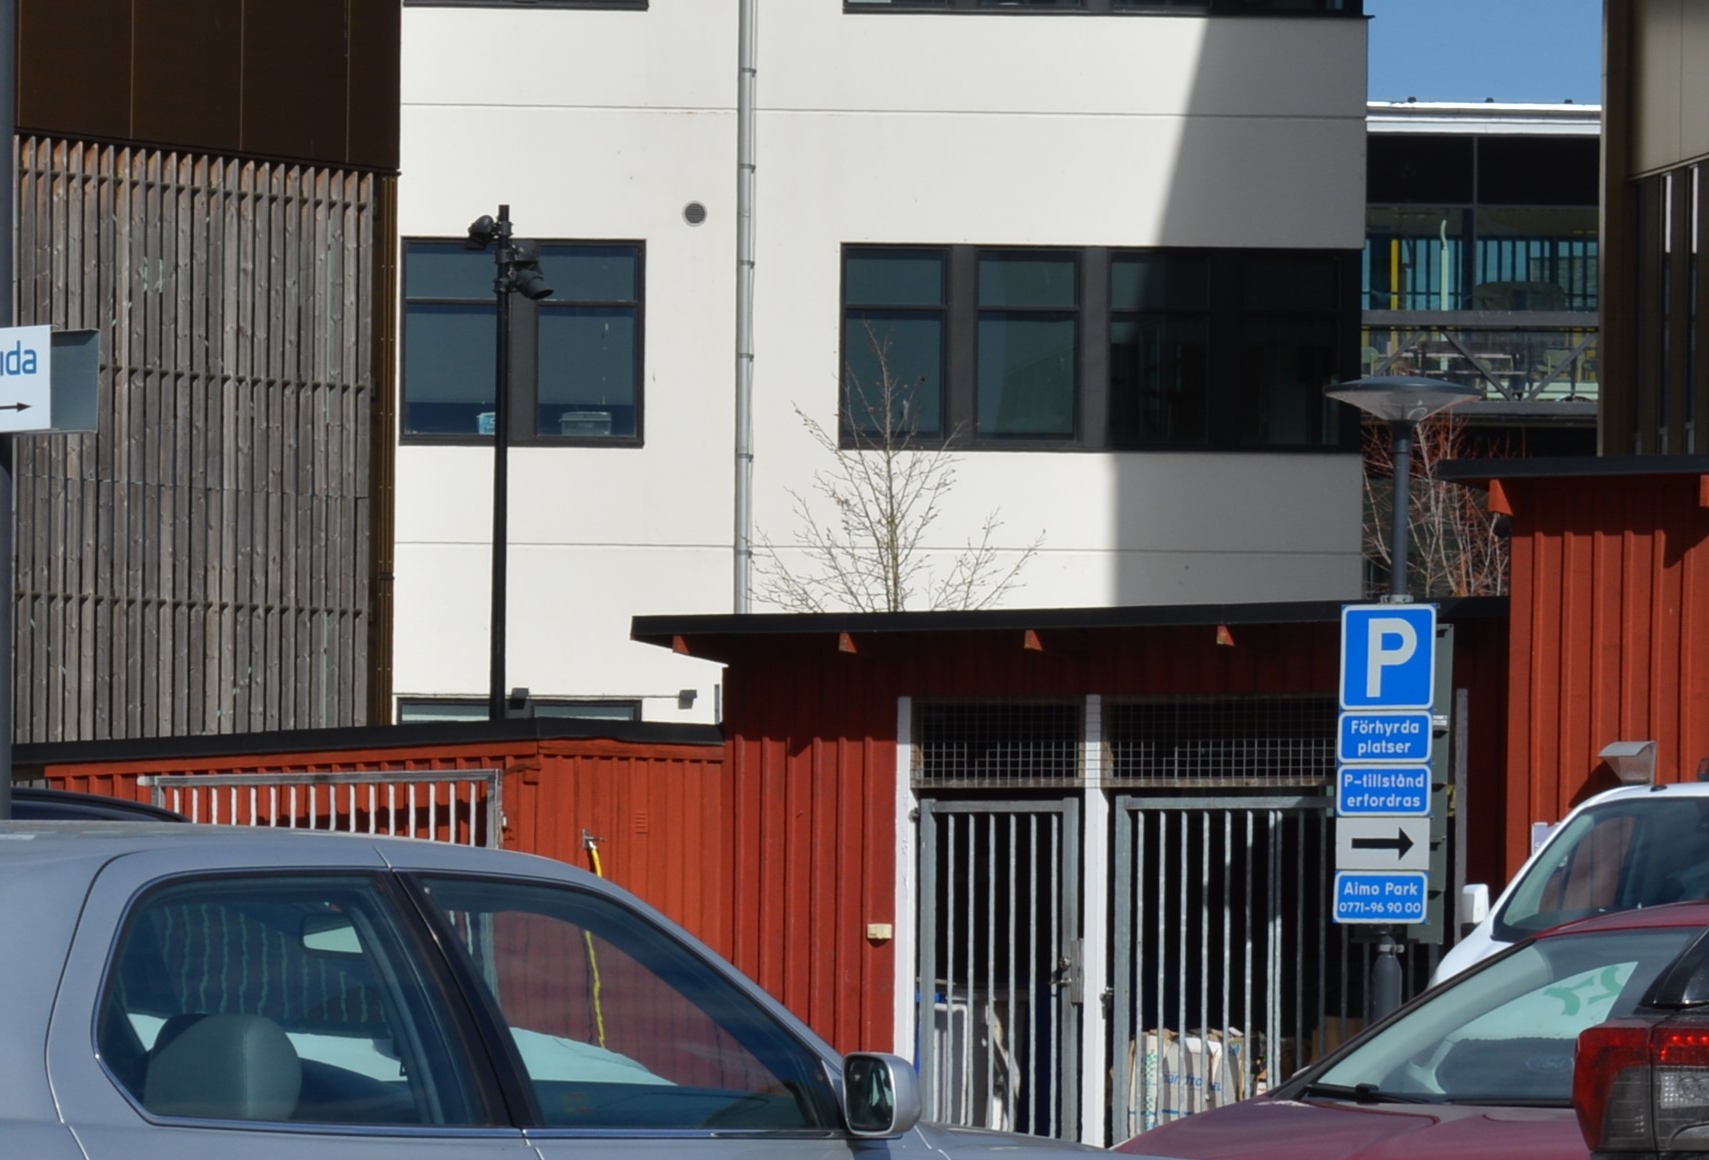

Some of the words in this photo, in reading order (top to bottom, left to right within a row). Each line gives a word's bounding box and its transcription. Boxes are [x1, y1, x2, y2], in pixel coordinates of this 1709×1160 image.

[1366, 617, 1418, 698] P
[1351, 720, 1420, 737] Förhyrda
[1357, 740, 1412, 757] platser
[1344, 773, 1425, 788] P-tillstånd
[1346, 793, 1421, 808] erfordras
[1343, 881, 1380, 896] Aimo
[1384, 881, 1419, 896] Park
[1338, 902, 1384, 913] 0771-96
[1386, 902, 1403, 913] 90
[1404, 902, 1422, 913] 00
